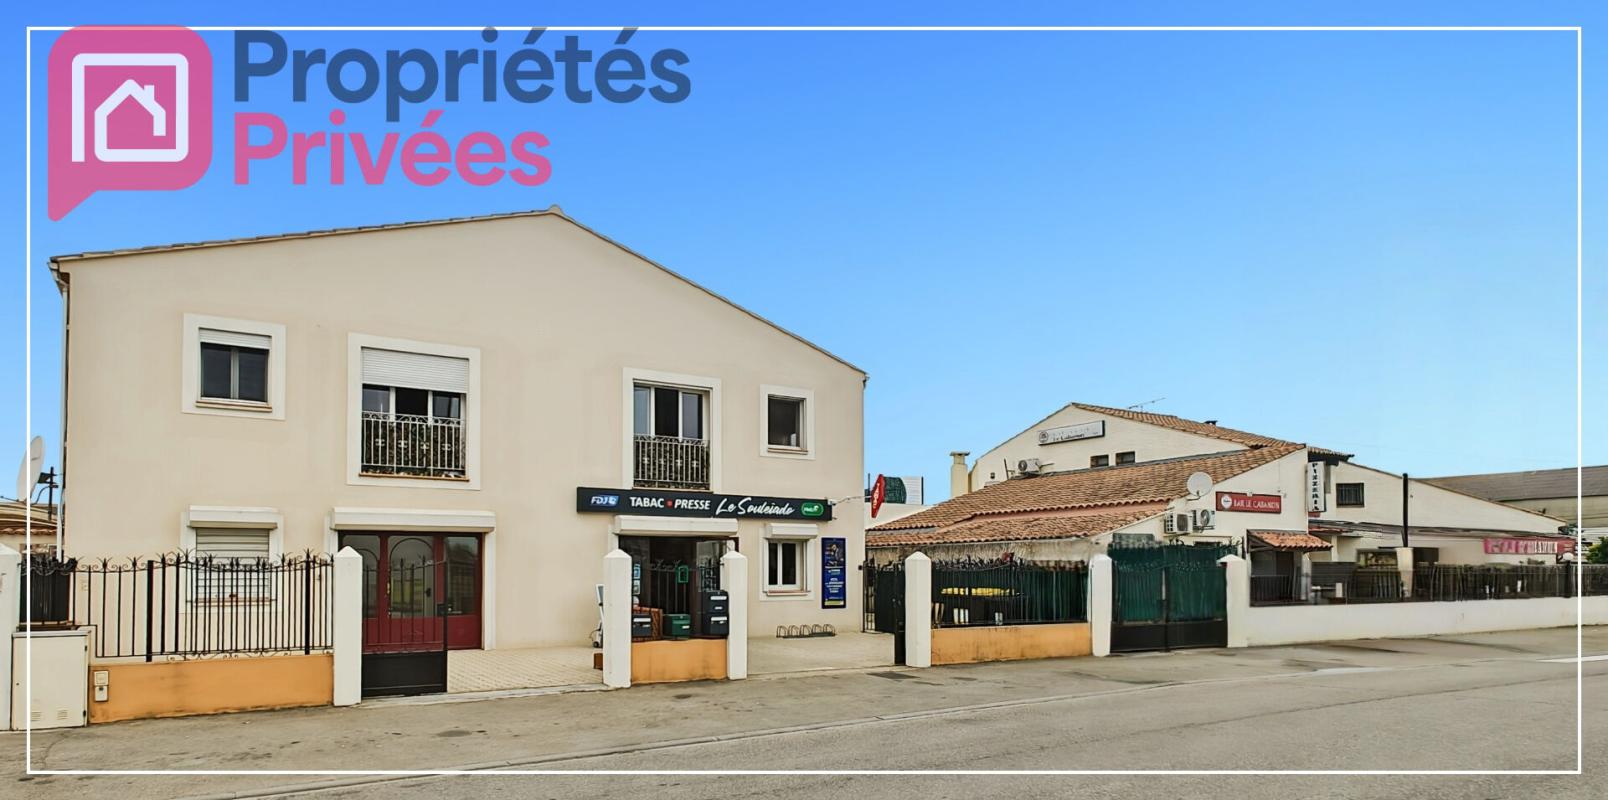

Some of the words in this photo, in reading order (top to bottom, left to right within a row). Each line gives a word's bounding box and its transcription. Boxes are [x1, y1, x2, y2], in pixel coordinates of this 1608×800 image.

[590, 495, 609, 506] FDJ
[629, 496, 665, 508] TABAC
[674, 499, 711, 510] PRESSE
[715, 498, 737, 516] Le
